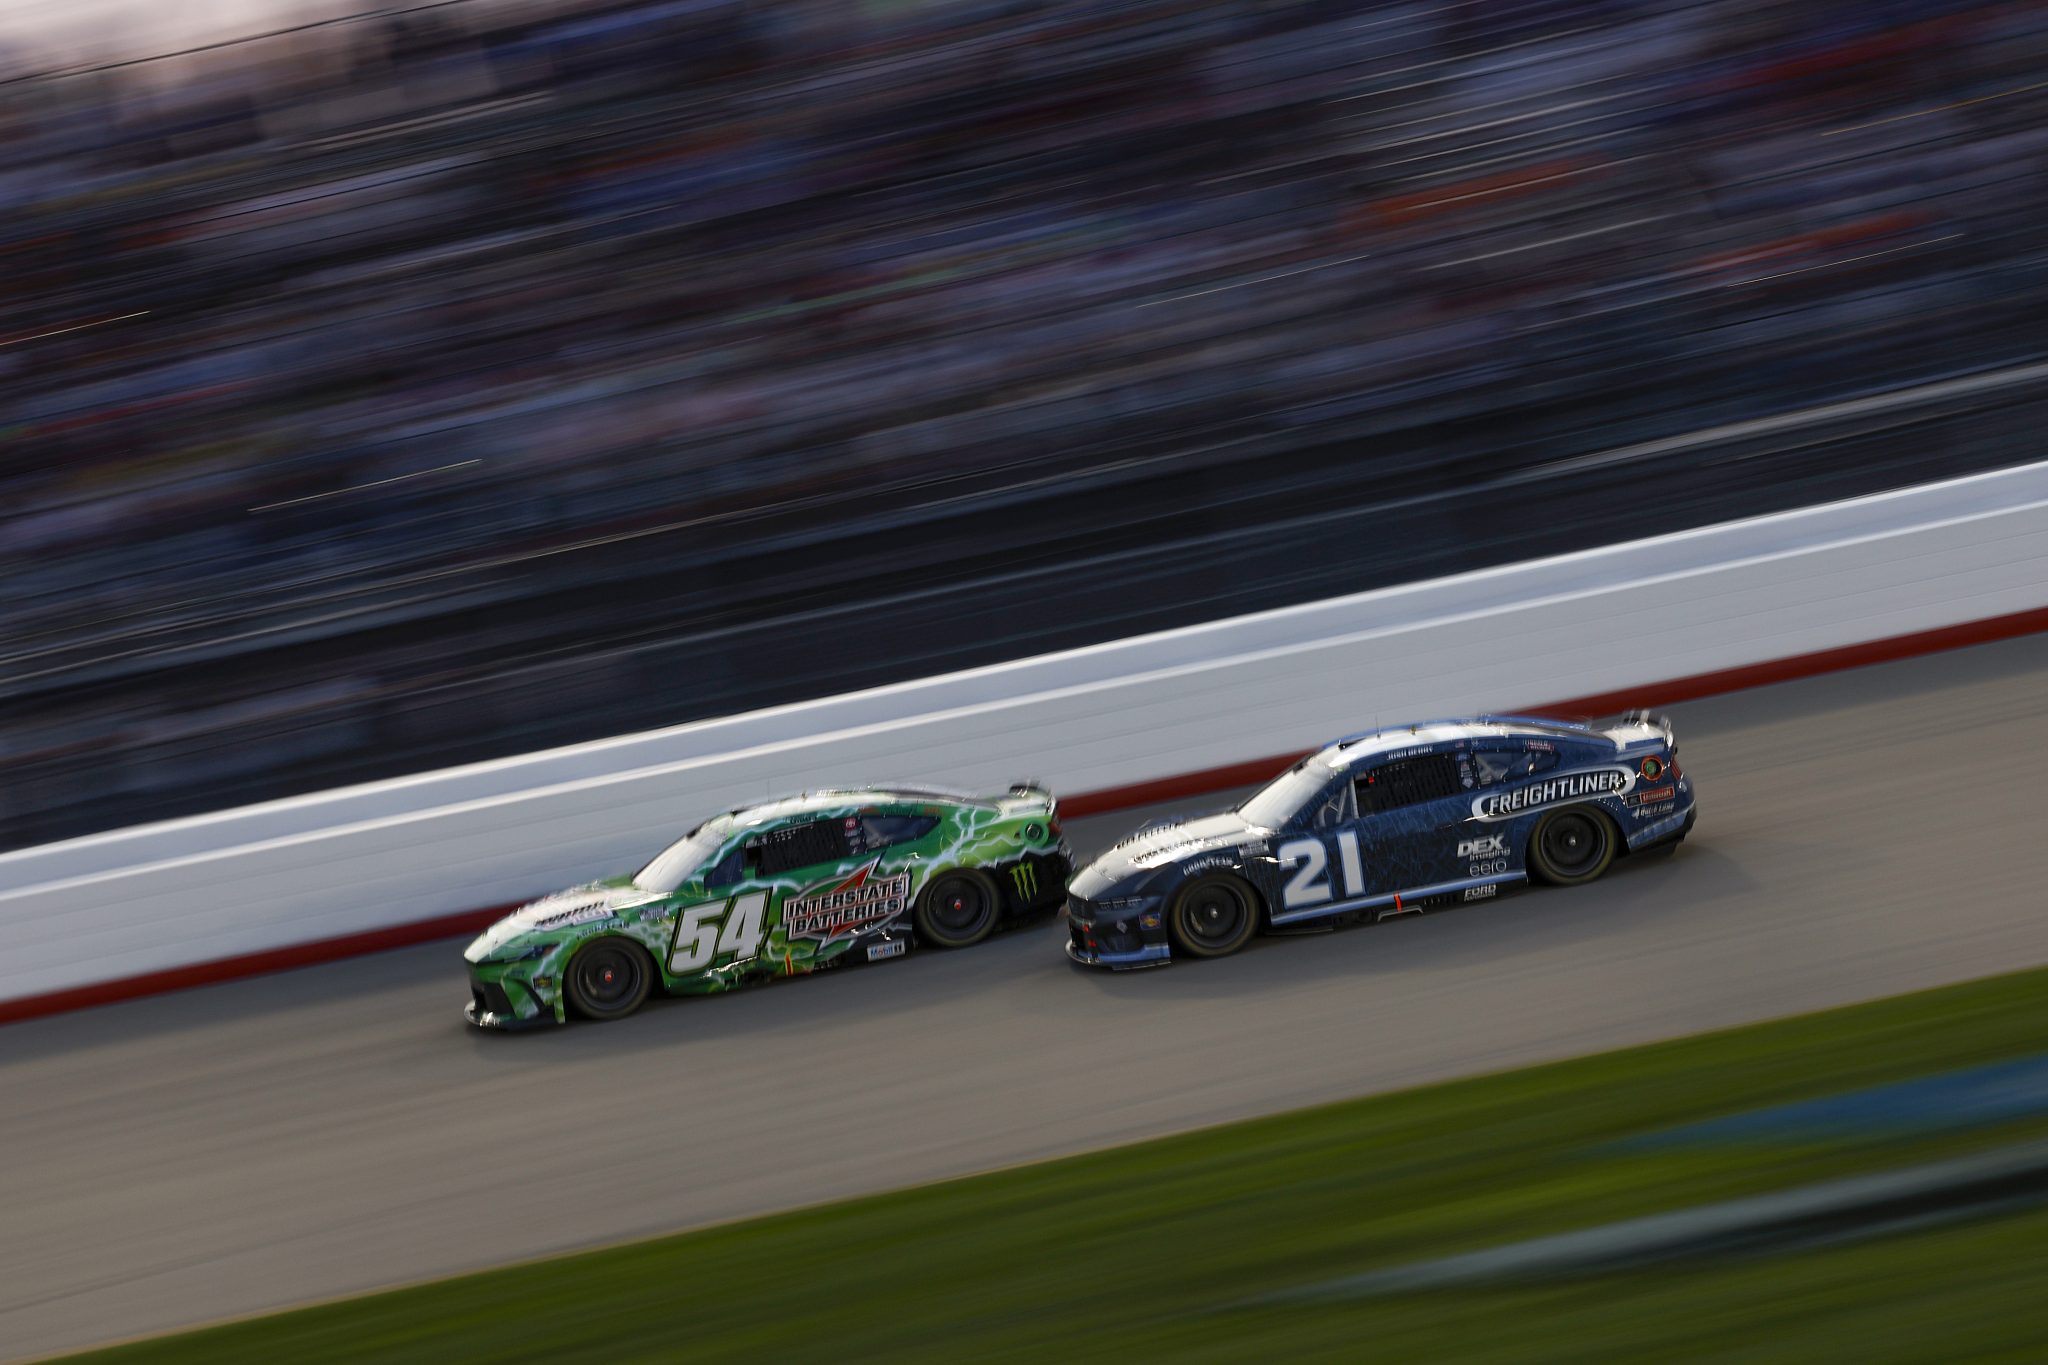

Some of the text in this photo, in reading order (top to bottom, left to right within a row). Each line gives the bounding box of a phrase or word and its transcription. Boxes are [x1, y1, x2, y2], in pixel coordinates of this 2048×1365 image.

[1489, 771, 1619, 813] FREIGHTLINER
[1457, 833, 1504, 857] DEX
[1278, 829, 1366, 910] 21
[1470, 858, 1507, 877] eero
[787, 878, 905, 918] INTERSTATE
[1464, 883, 1497, 898] FORD
[668, 888, 771, 975] 54
[794, 899, 902, 934] BATTERIES
